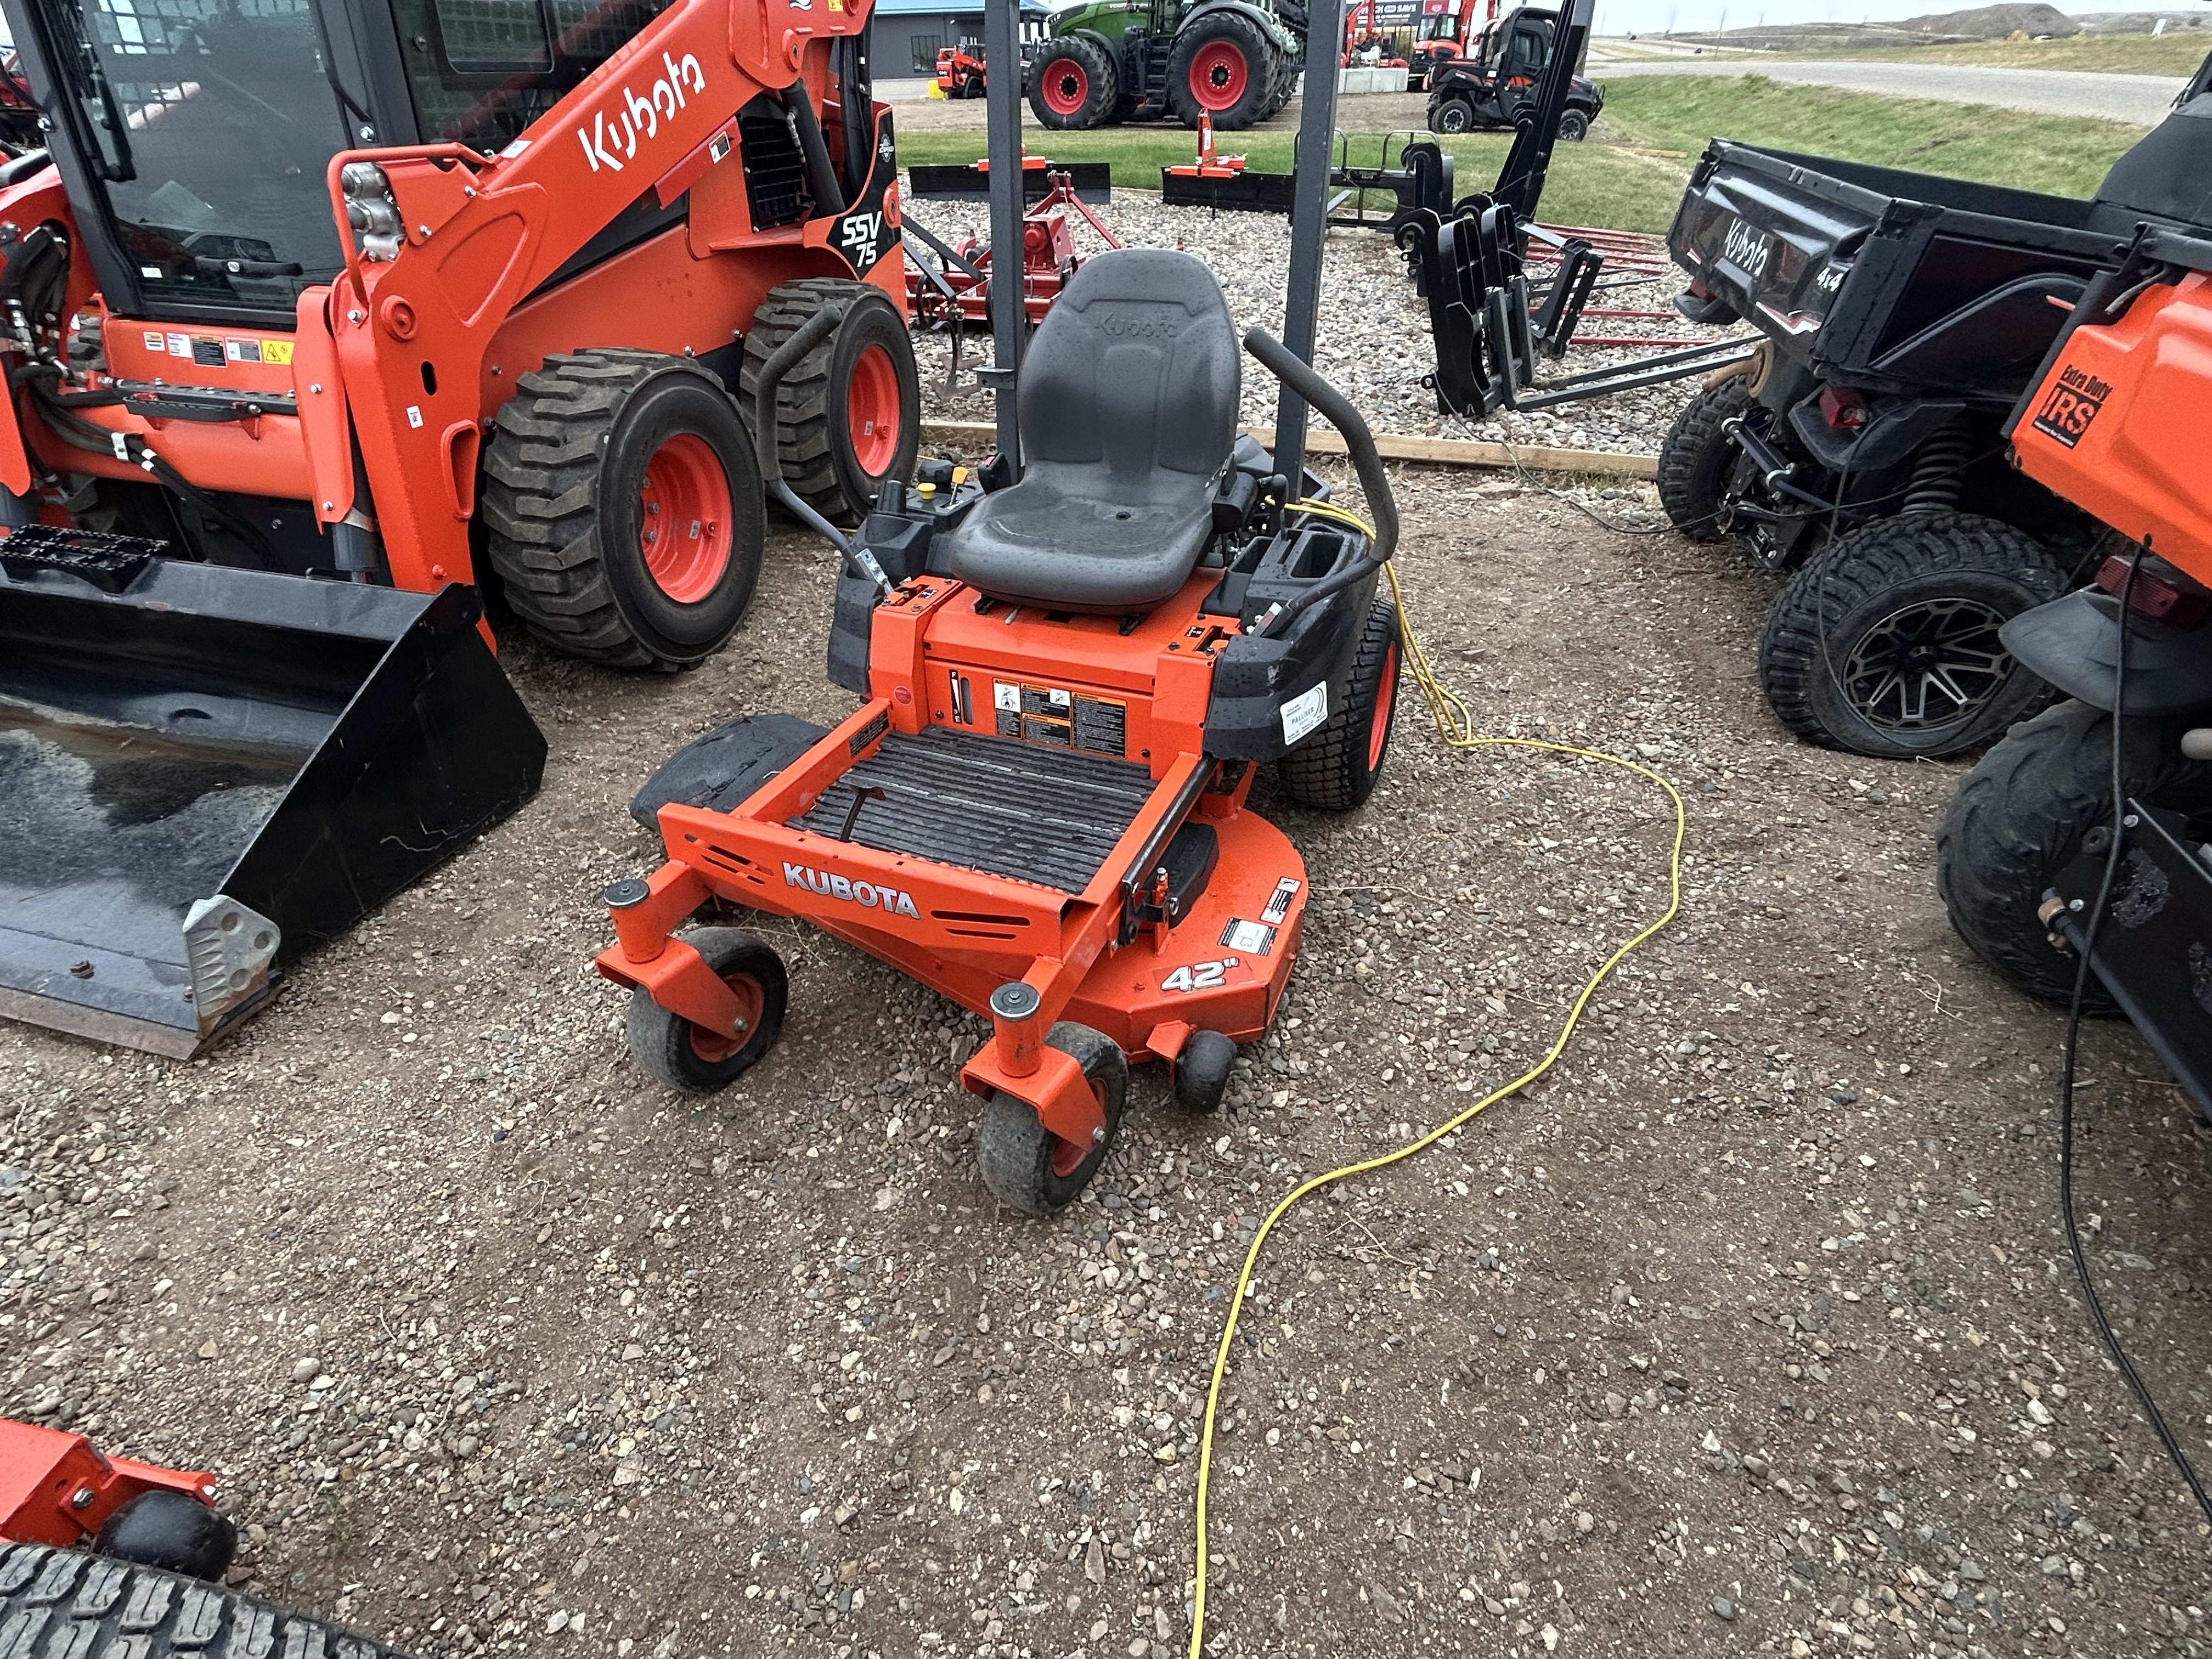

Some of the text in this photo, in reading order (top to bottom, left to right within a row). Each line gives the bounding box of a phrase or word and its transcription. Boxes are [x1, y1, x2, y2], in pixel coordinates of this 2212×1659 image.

[577, 51, 706, 172] Kubota
[842, 211, 882, 247] SSV
[1725, 217, 1768, 276] Kubota
[856, 241, 877, 268] 75
[2060, 364, 2113, 402] Extra Duty
[2039, 387, 2095, 435] IRS
[782, 861, 922, 919] KUBOTA
